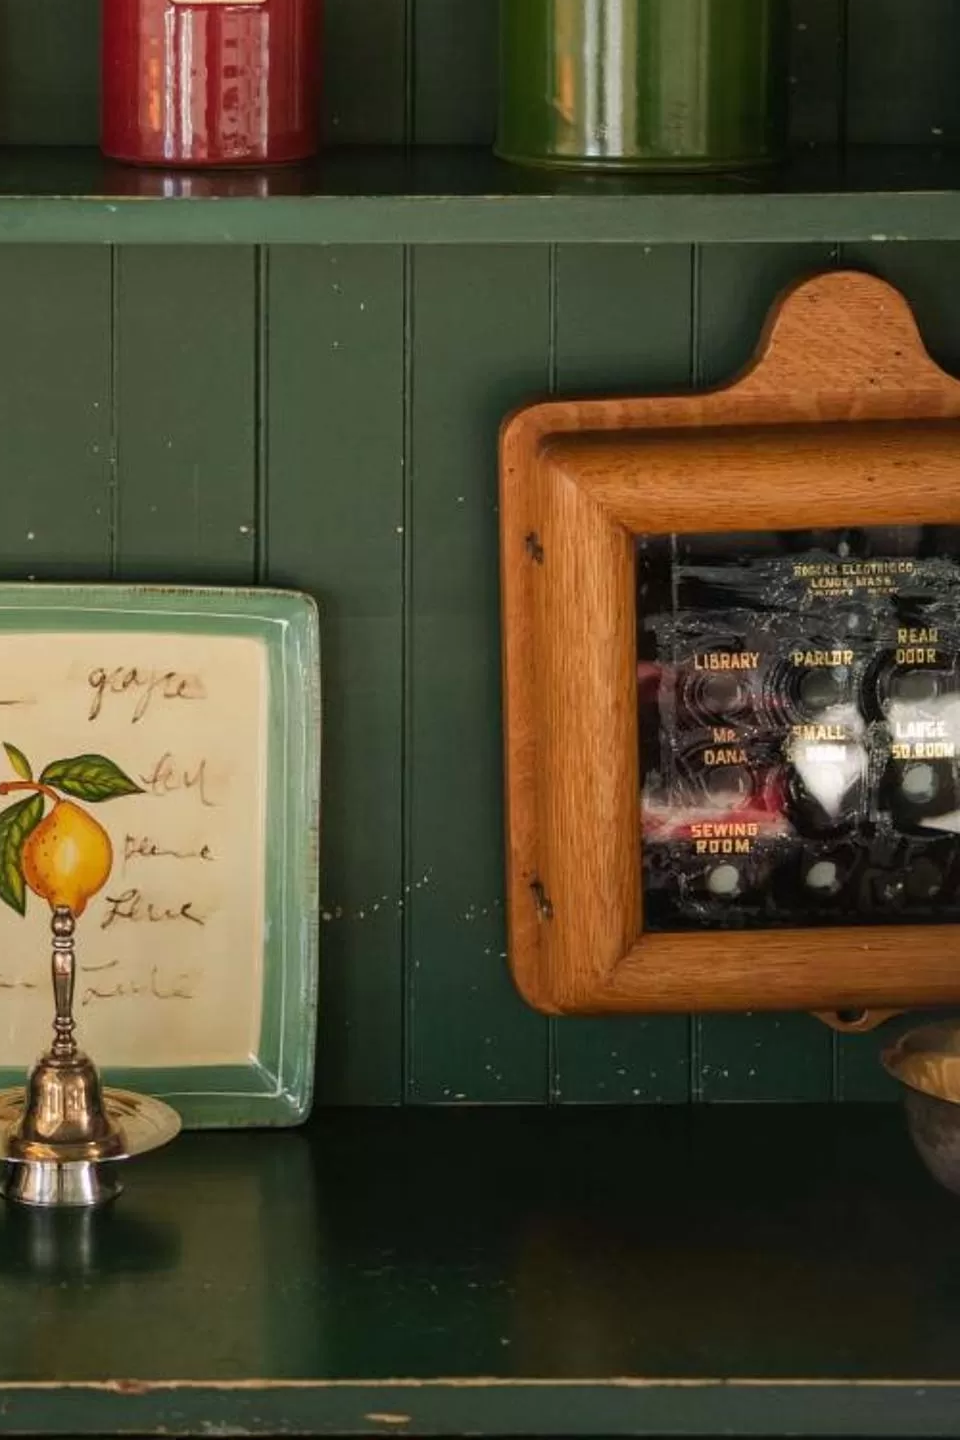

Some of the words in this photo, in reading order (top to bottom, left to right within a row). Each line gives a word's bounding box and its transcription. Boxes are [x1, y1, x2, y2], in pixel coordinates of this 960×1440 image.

[897, 628, 938, 644] REAR
[694, 652, 759, 670] LIBRARY
[793, 650, 854, 666] PARLOR
[896, 648, 936, 664] DOOR
[792, 724, 846, 741] SMALL
[704, 749, 748, 765] DANA
[691, 823, 758, 839] SEWING
[696, 839, 750, 854] ROOM
